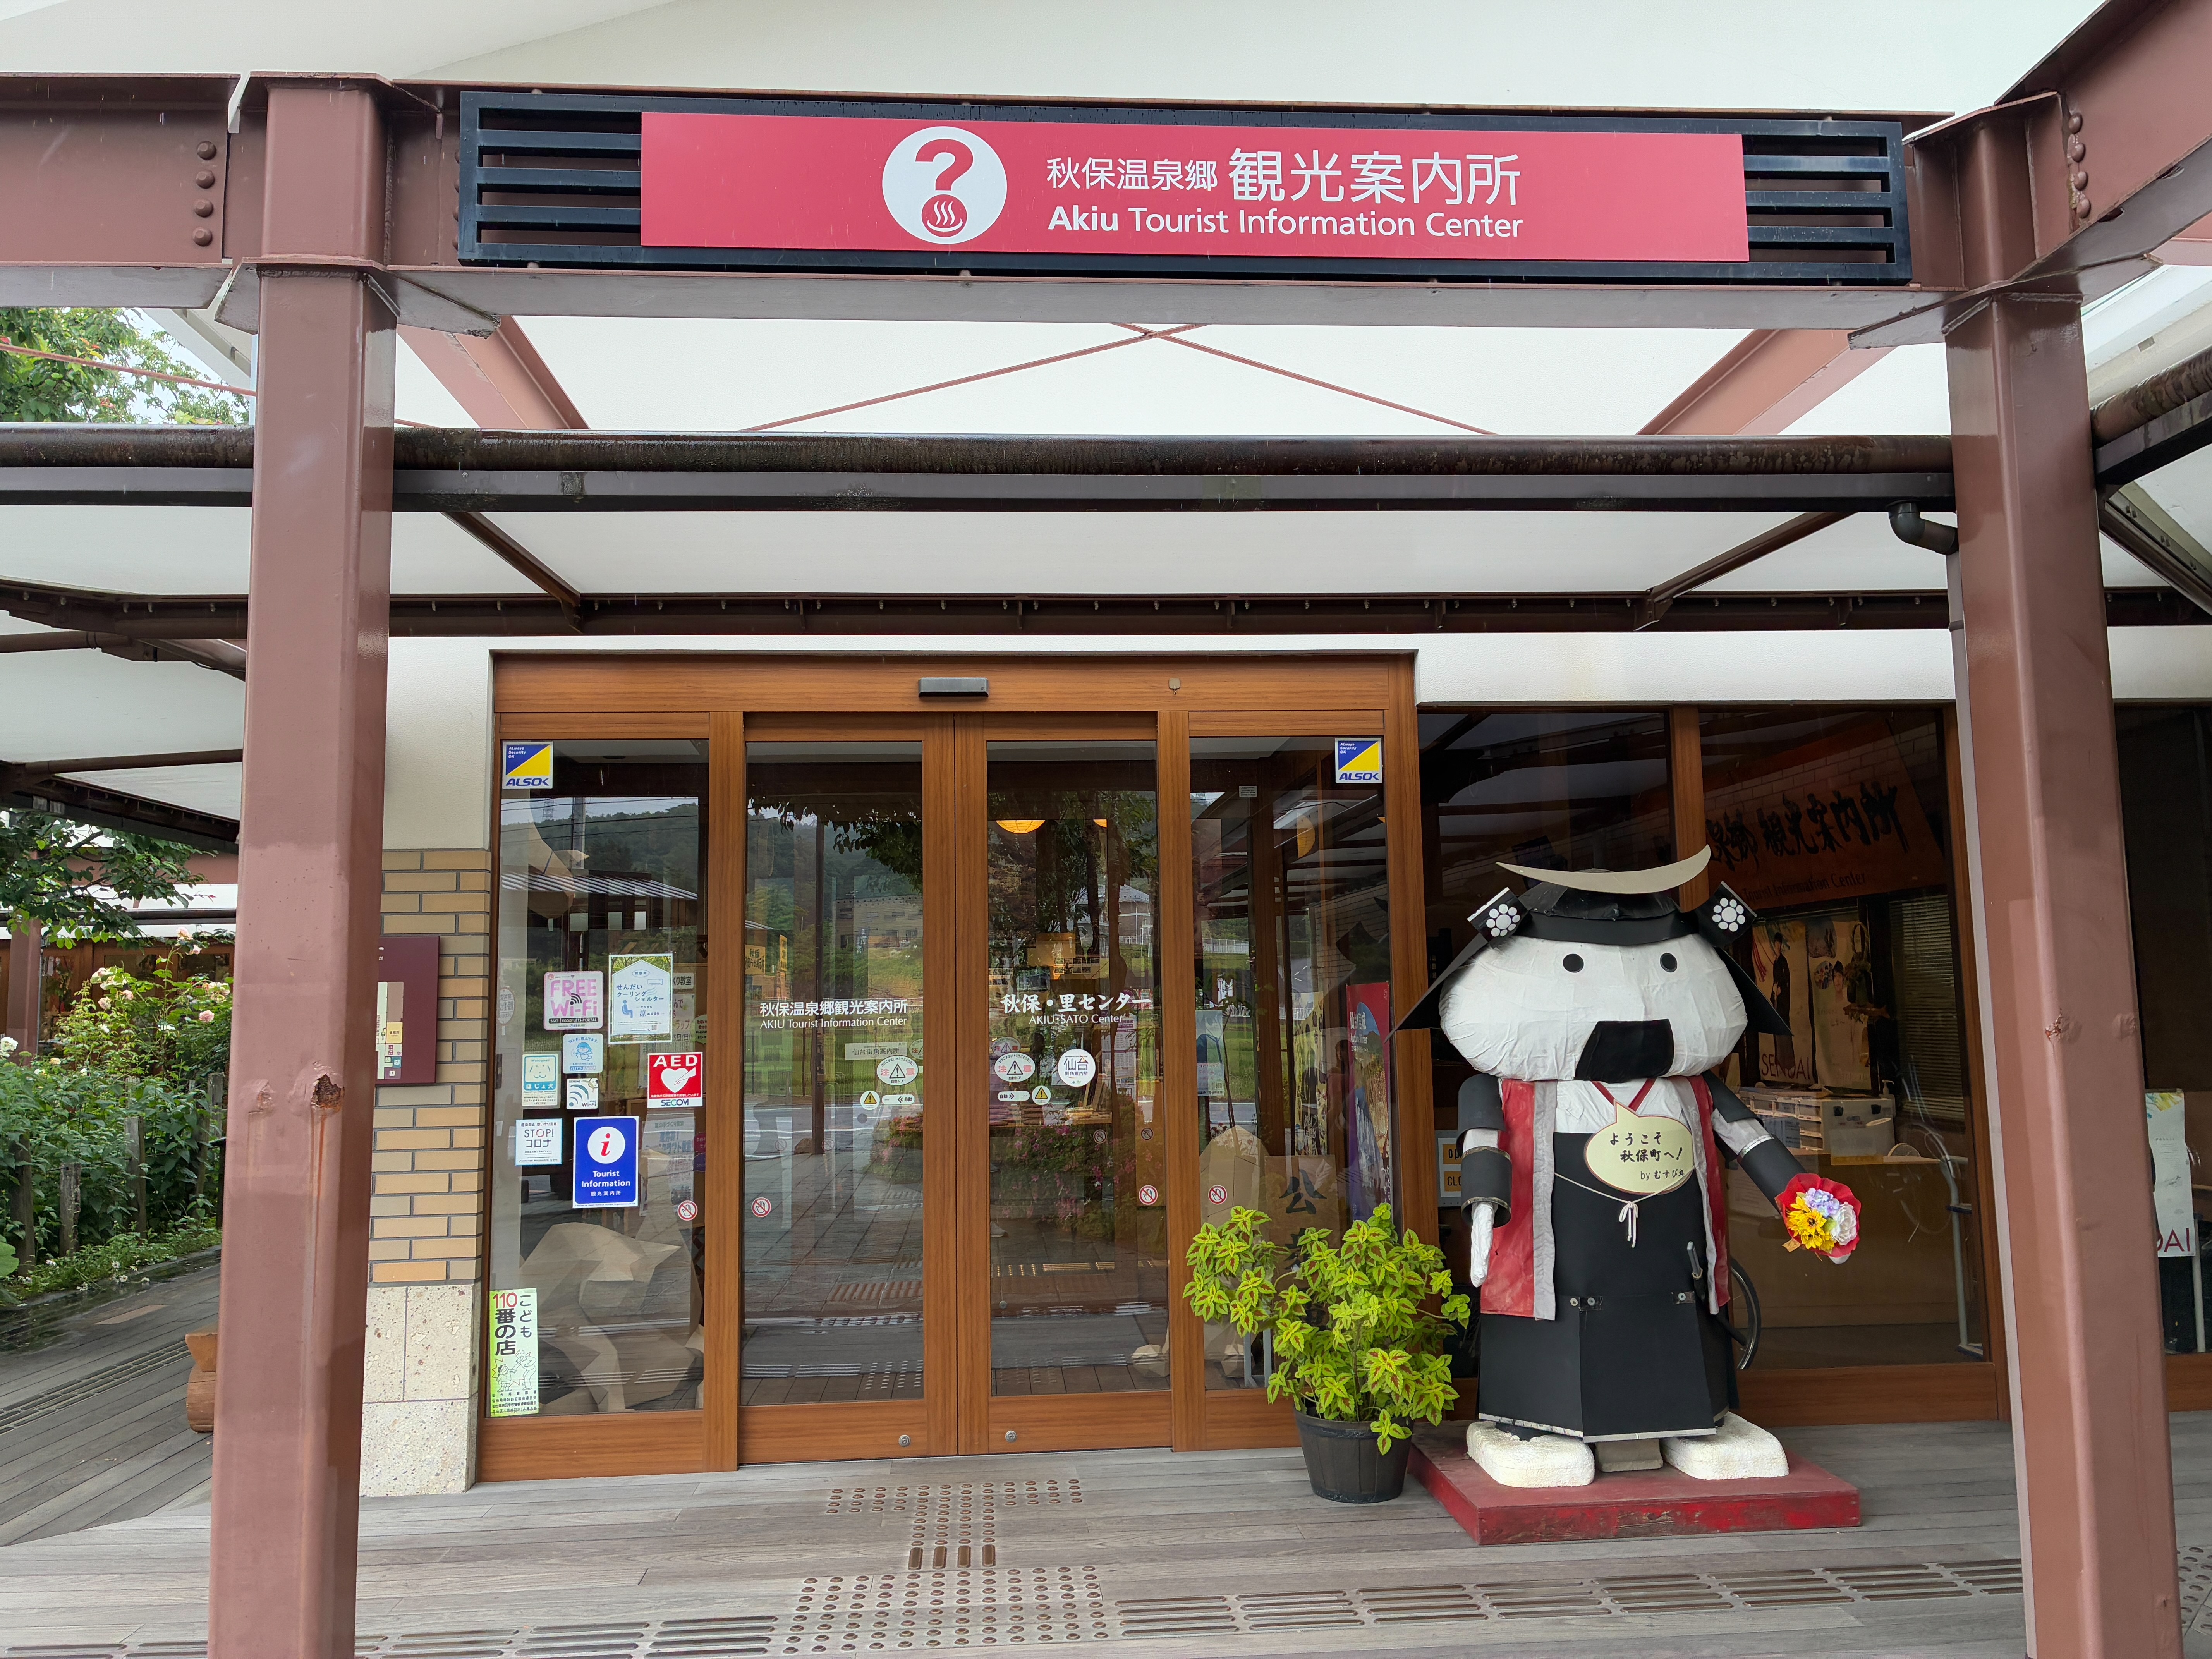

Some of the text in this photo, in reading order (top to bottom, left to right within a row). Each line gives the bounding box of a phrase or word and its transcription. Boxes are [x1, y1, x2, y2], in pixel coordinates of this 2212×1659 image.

[1046, 148, 1520, 206] 秋保温泉郷 観光案内所
[1048, 205, 1523, 237] Akiu Tourist Information Center
[505, 778, 550, 786] ALSOK
[550, 979, 597, 998] FREE
[550, 999, 597, 1017] Wi-Fi
[760, 999, 908, 1017] 秋保温泉郷観光案内所
[1000, 992, 1151, 1014] 秋保・里センター
[760, 1016, 907, 1029] AKIU Tourist Information Center
[1091, 1013, 1123, 1024] Center
[852, 1047, 900, 1056] 仙台街角案内所
[653, 1055, 697, 1067] AED
[1064, 1057, 1088, 1071] 仙台
[524, 1128, 554, 1138] STOP!
[1609, 1132, 1661, 1146] ようこそ
[526, 1139, 551, 1148] コロナ
[1620, 1147, 1683, 1163] 秋保町へ!
[1640, 1168, 1685, 1181] by むすび丸
[581, 1180, 631, 1188] Information
[520, 1295, 532, 1338] こども
